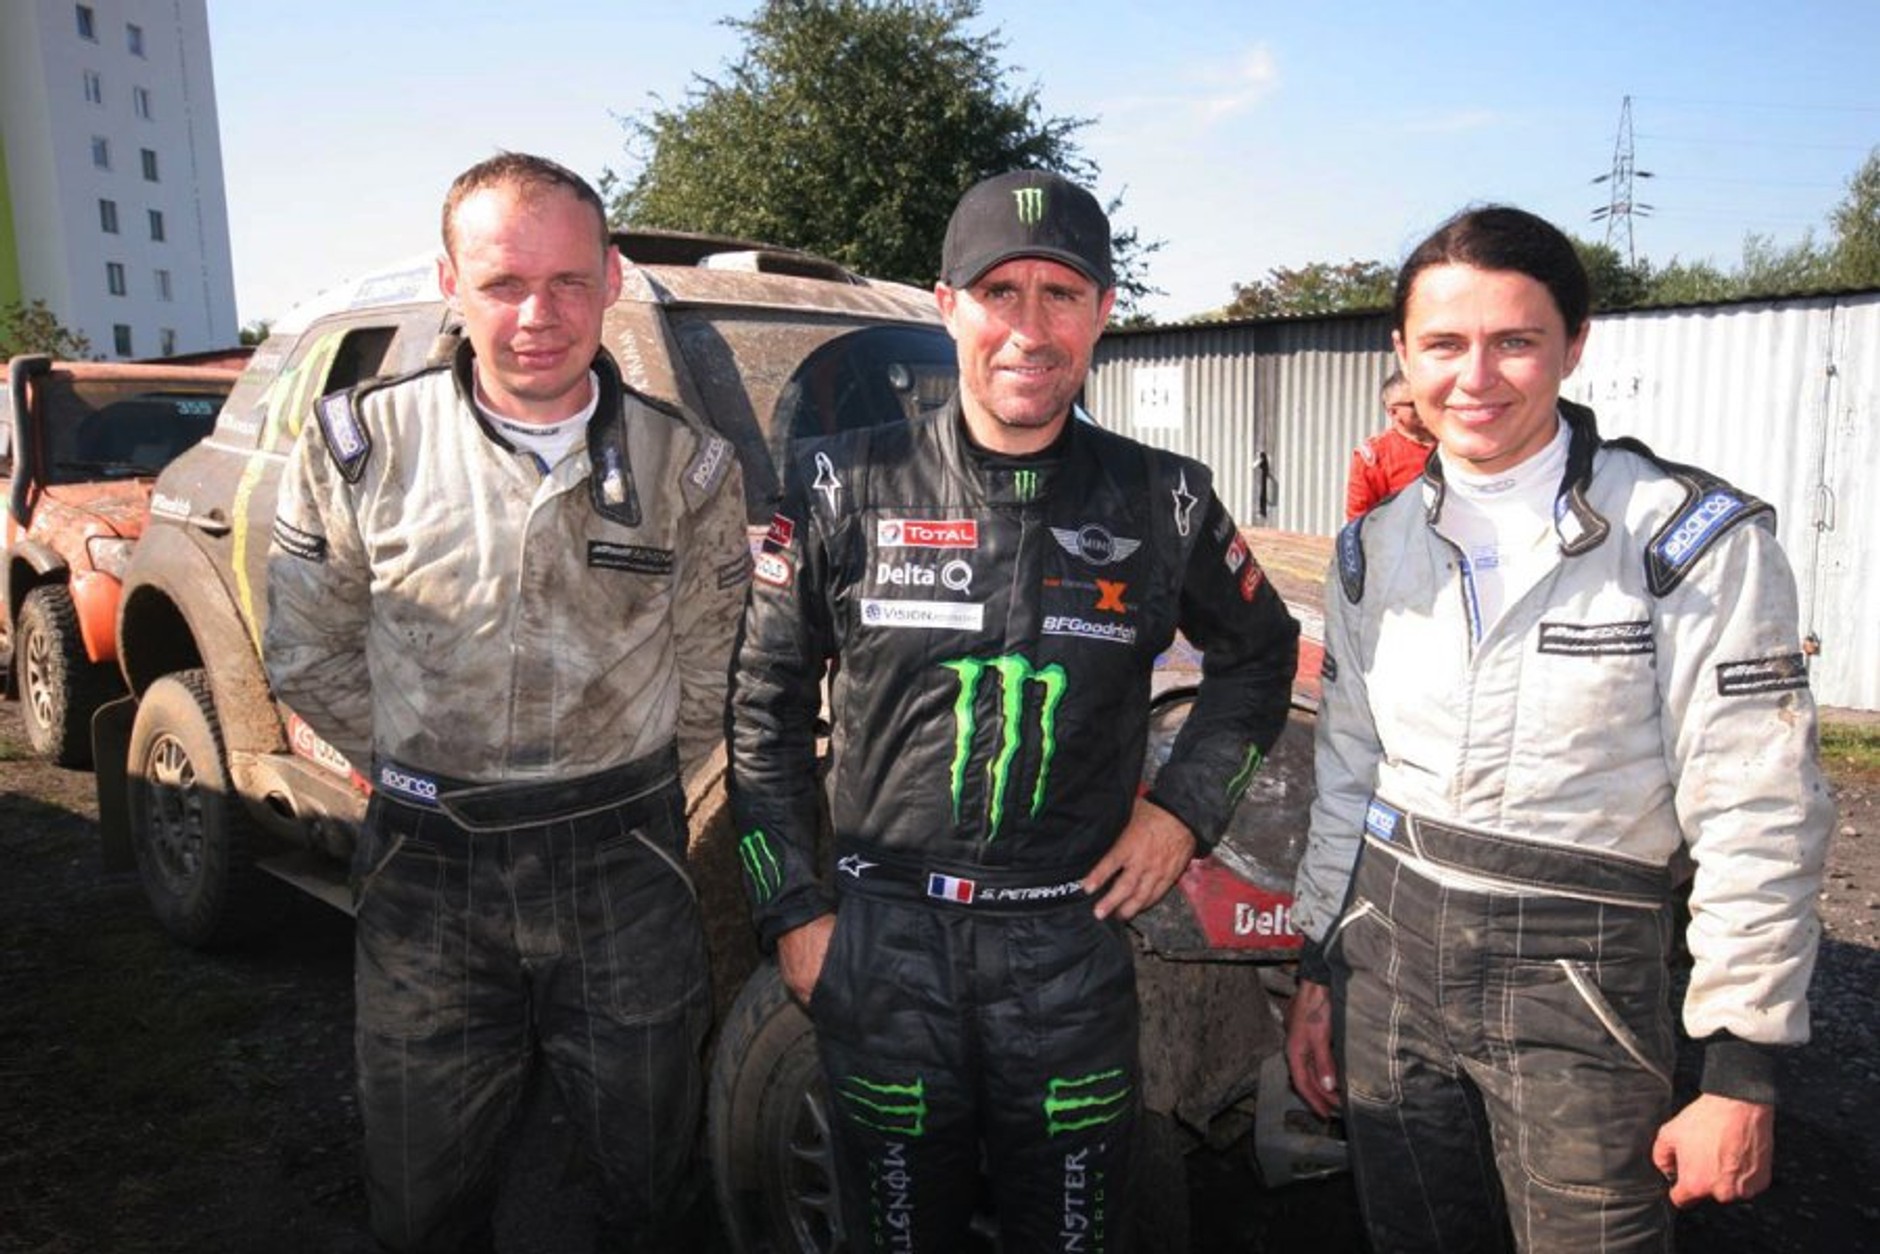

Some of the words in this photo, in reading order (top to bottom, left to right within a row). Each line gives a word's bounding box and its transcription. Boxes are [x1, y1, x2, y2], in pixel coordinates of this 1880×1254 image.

[906, 526, 974, 541] TOTAL
[1665, 495, 1738, 561] sparco
[876, 562, 935, 586] Delta
[381, 767, 437, 799] sparco
[882, 1141, 913, 1254] MONST
